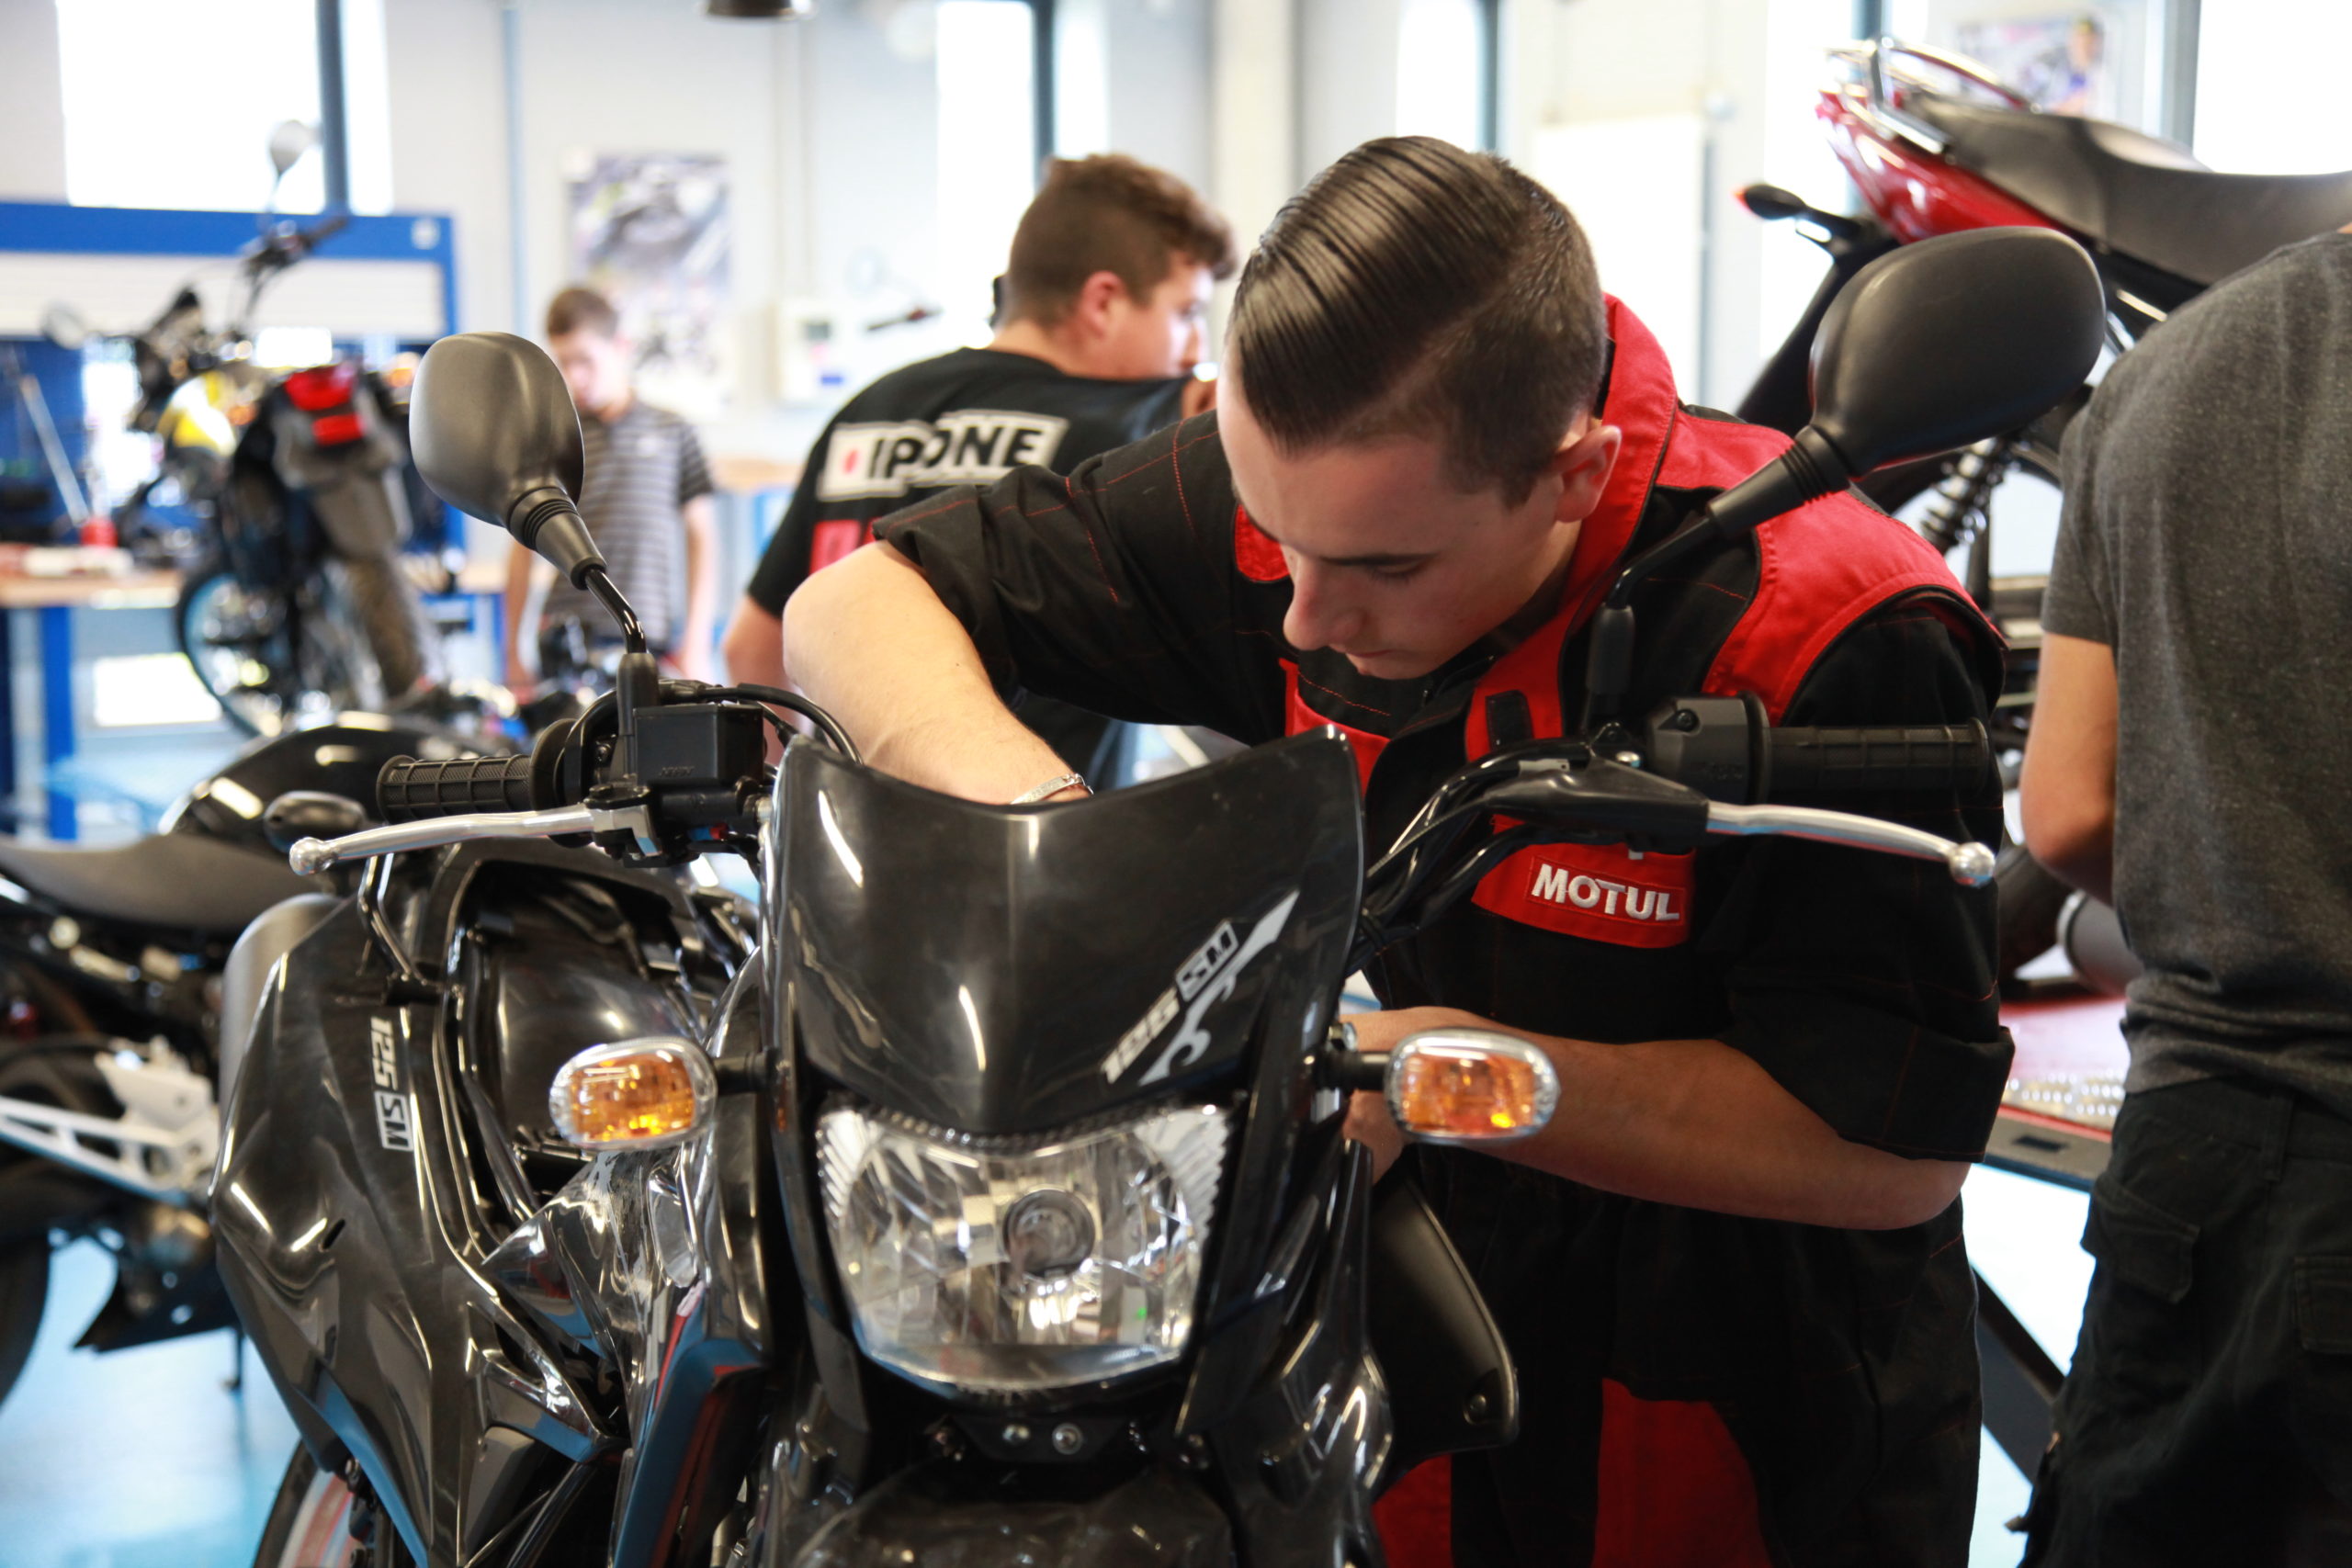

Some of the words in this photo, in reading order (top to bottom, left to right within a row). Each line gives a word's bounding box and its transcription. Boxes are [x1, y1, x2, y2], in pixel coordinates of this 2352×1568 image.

[1531, 863, 1680, 921] MOTUL
[370, 1016, 399, 1091] 125
[379, 1095, 410, 1147] SM
